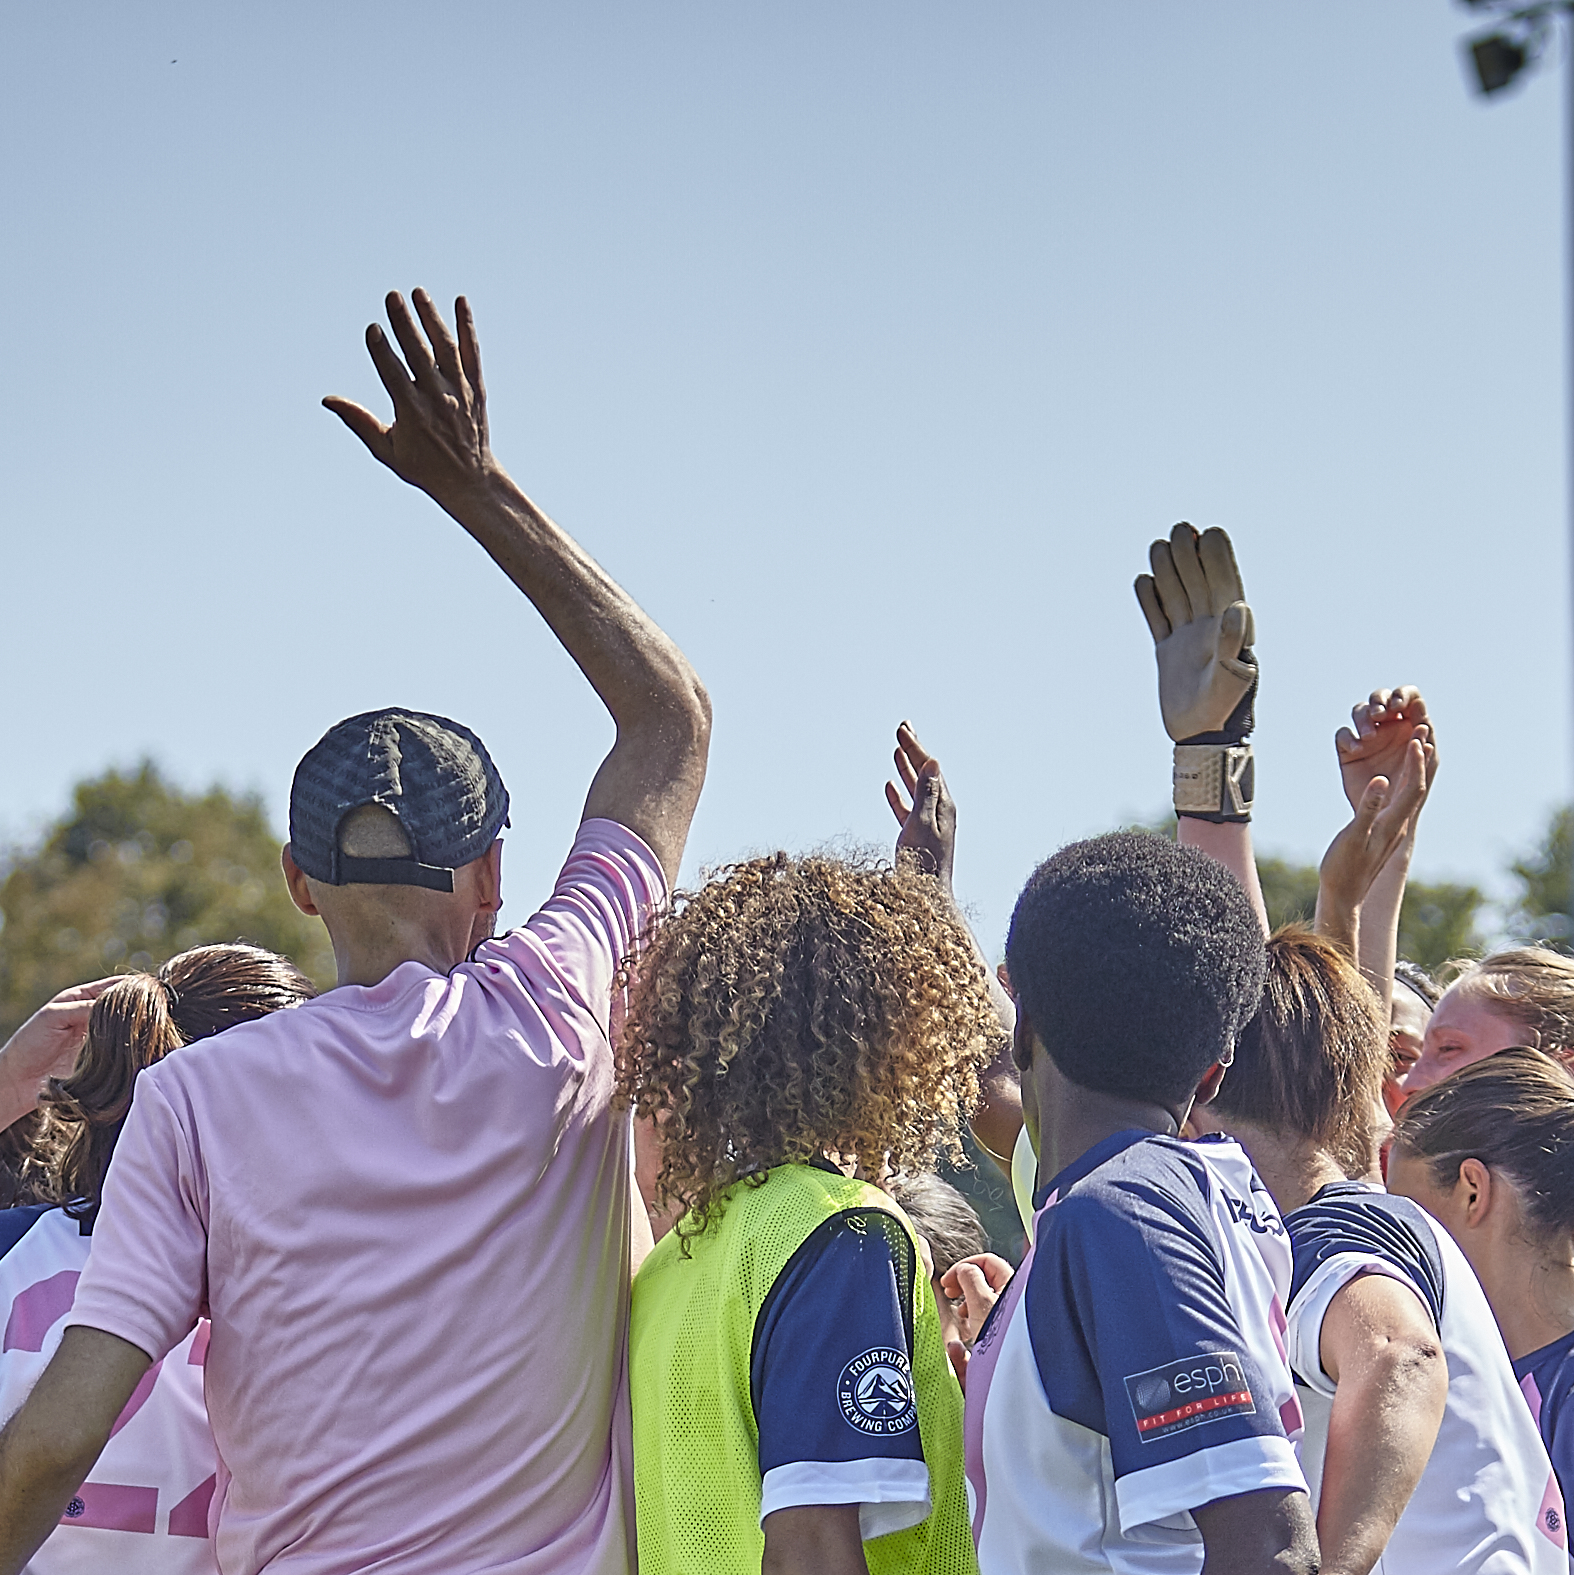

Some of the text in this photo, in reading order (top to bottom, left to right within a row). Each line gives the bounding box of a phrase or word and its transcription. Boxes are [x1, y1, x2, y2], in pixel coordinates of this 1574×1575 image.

[848, 1351, 911, 1377] FOURPURE
[1173, 1357, 1240, 1393] esph
[840, 1391, 883, 1432] BREWING
[887, 1403, 918, 1432] COMP
[1143, 1392, 1247, 1427] FIT FOR LIFE
